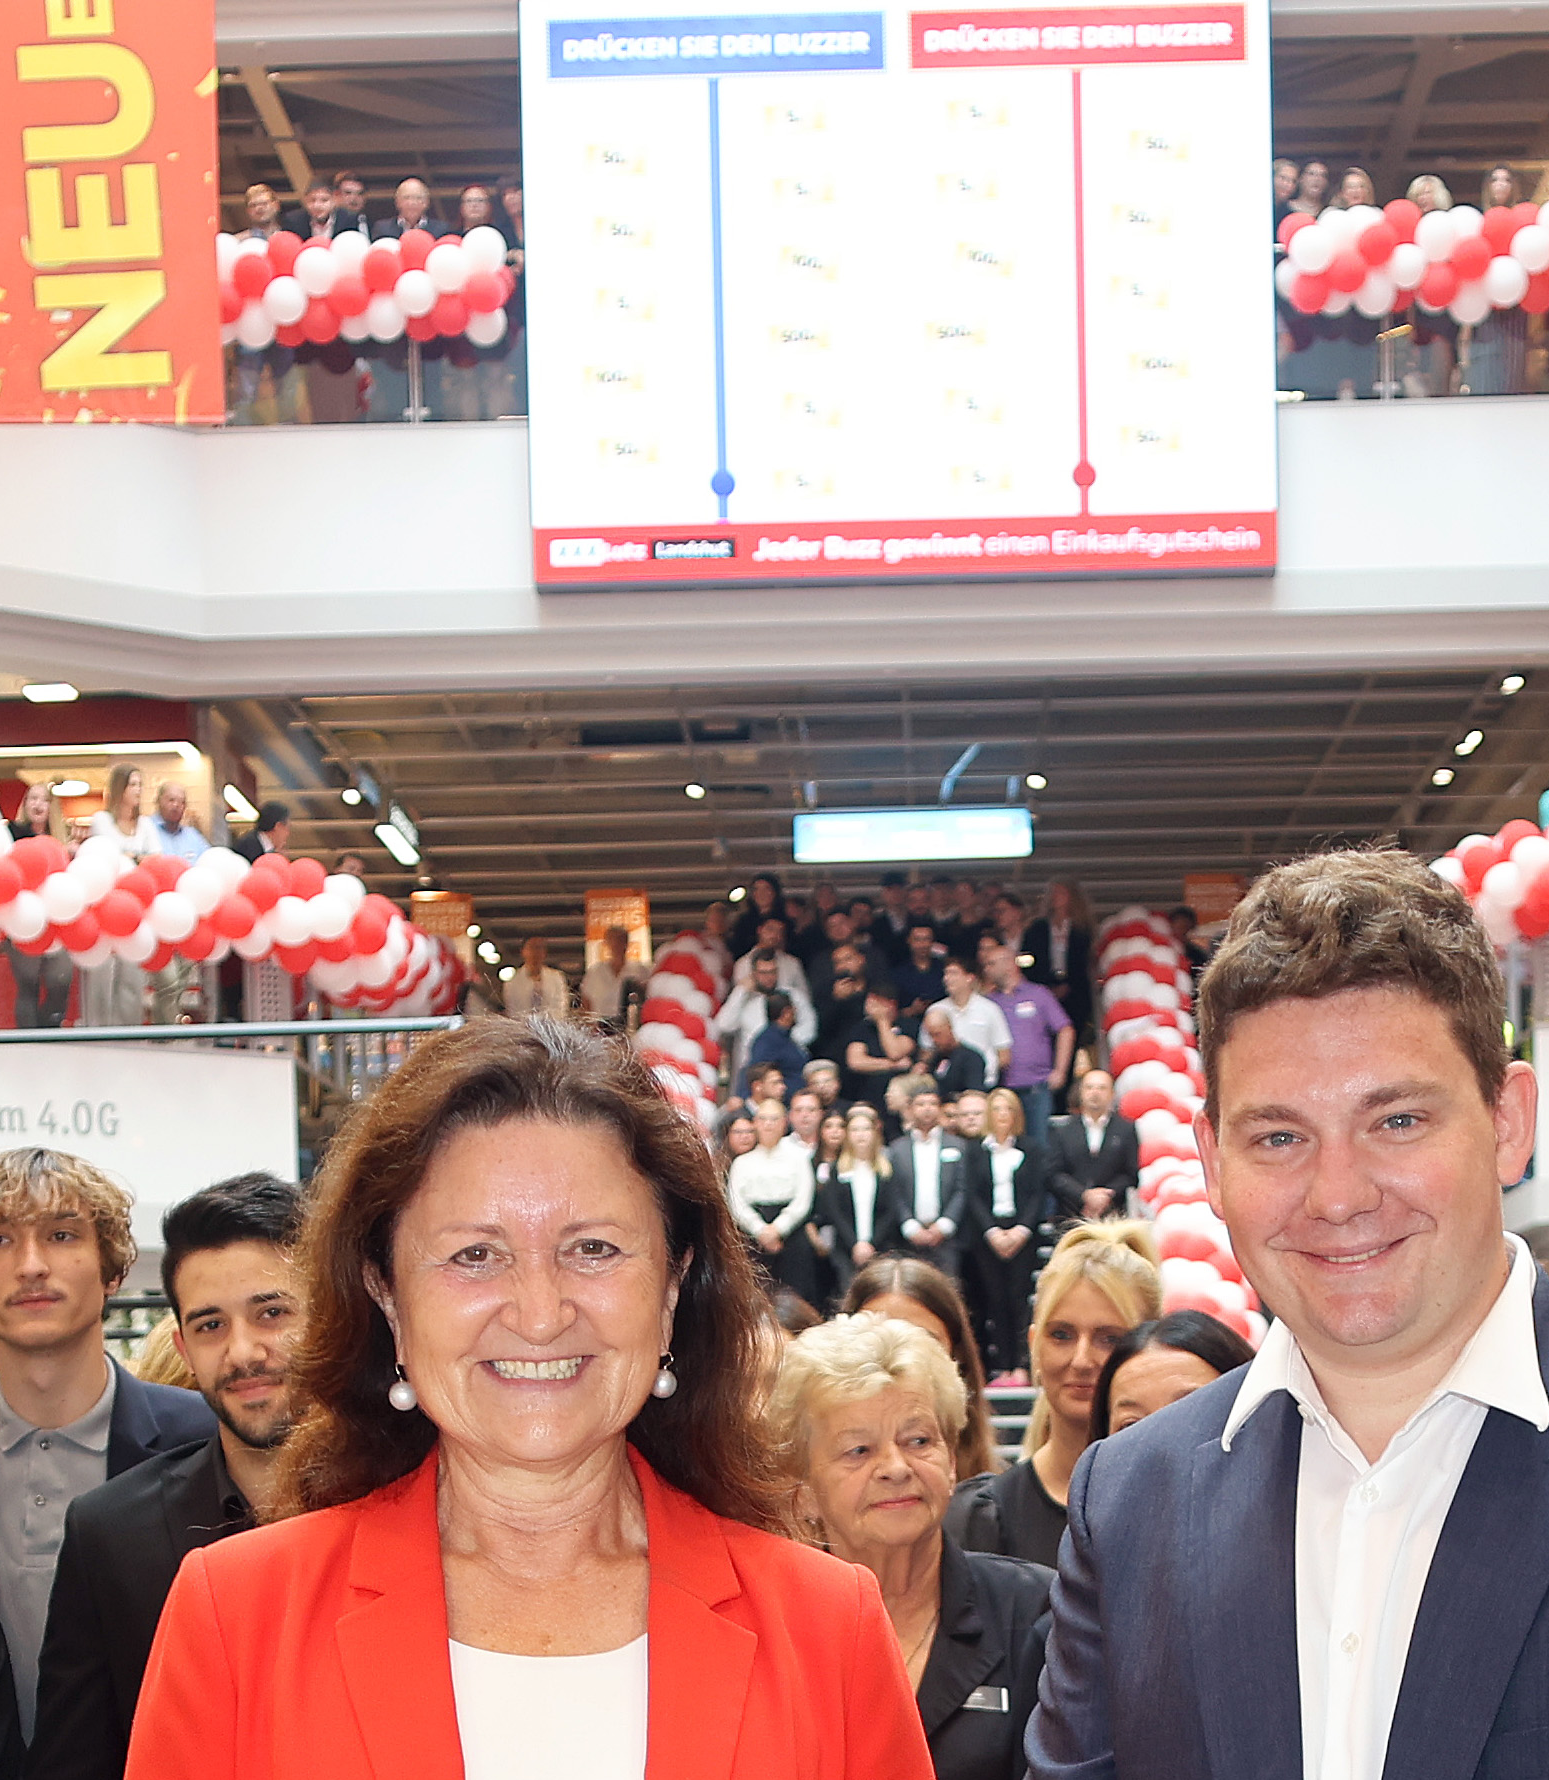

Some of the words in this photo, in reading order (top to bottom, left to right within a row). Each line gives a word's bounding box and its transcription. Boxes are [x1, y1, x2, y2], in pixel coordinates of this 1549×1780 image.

[562, 33, 677, 62] DRÜCKEN
[679, 35, 718, 59] SIE
[720, 34, 772, 58] DEN
[773, 31, 870, 56] BUZZER
[923, 24, 1039, 53] DRÜCKEN
[1041, 26, 1081, 50] SIE
[1082, 25, 1134, 49] DEN
[1135, 22, 1233, 47] BUZZER
[753, 536, 822, 562] Jeder
[823, 535, 882, 560] Buzz
[884, 532, 983, 563] gewinnt
[984, 531, 1050, 556] einen
[1052, 525, 1261, 558] Einkaufsgutschein
